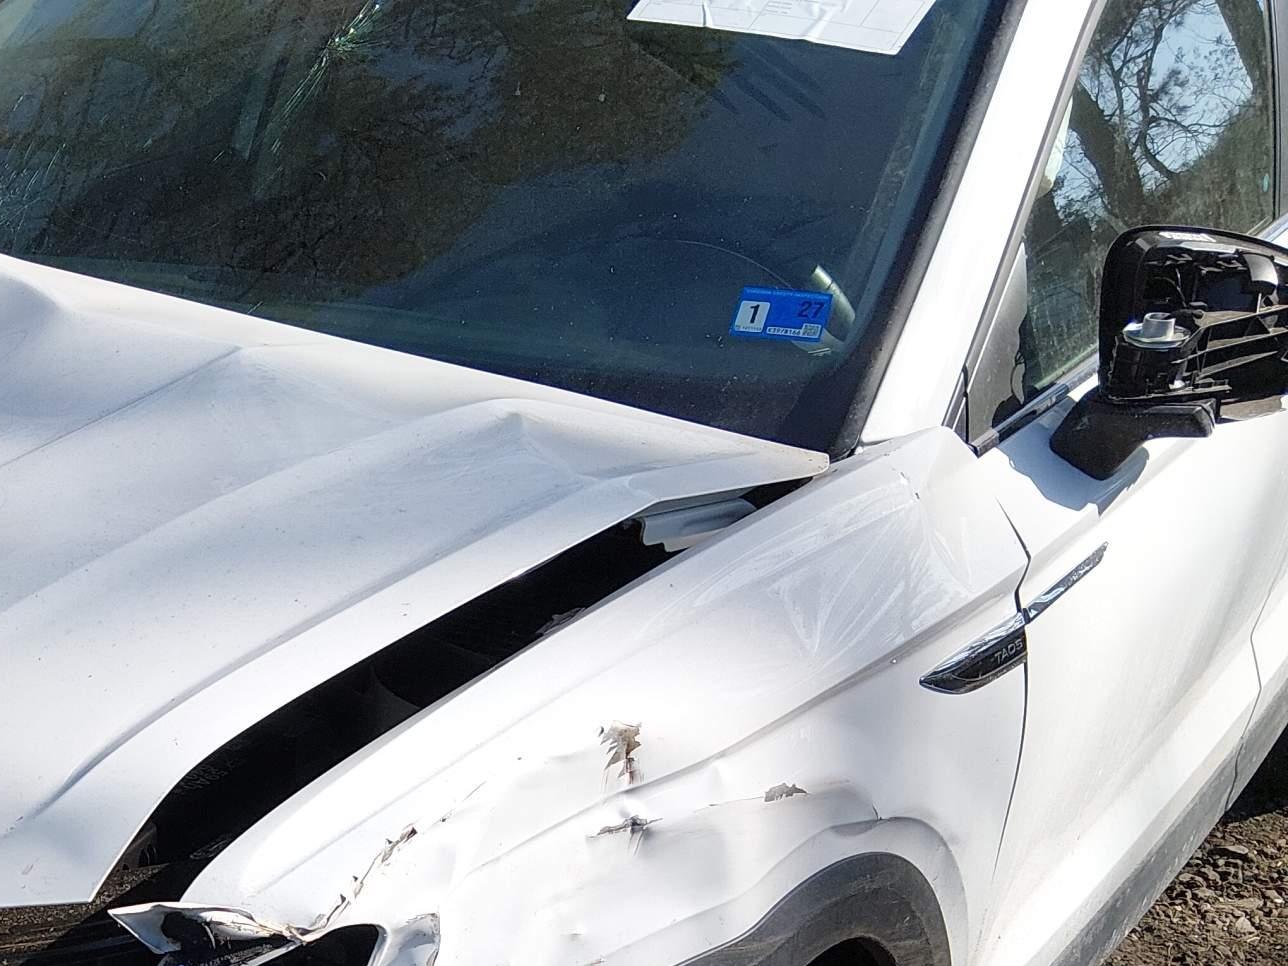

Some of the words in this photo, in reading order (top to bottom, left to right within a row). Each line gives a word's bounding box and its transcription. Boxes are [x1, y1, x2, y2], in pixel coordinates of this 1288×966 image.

[750, 304, 760, 324] 1
[797, 301, 826, 319] 27
[994, 638, 1023, 664] TAOS
